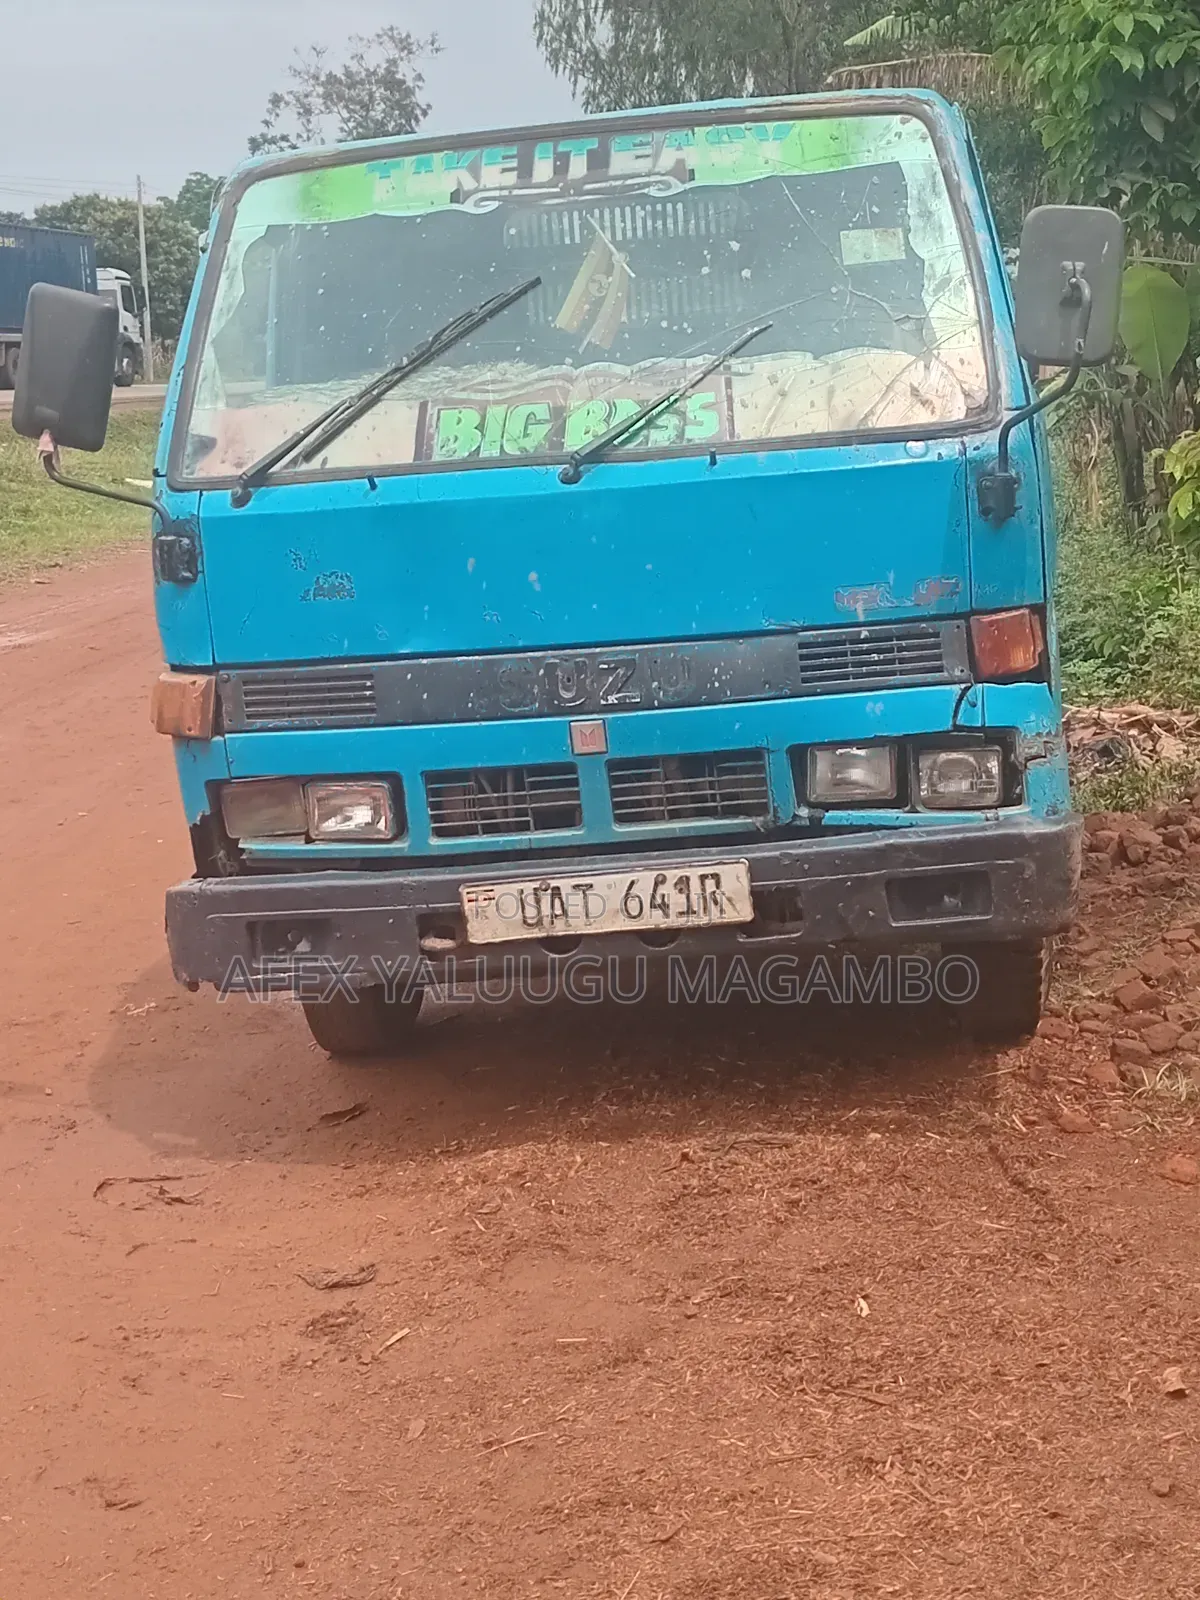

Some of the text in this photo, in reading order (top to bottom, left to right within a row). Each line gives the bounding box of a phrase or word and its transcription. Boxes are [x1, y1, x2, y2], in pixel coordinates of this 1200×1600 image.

[365, 122, 796, 203] TAKE IT EASY
[433, 400, 554, 460] BIG
[516, 882, 595, 931] UAT
